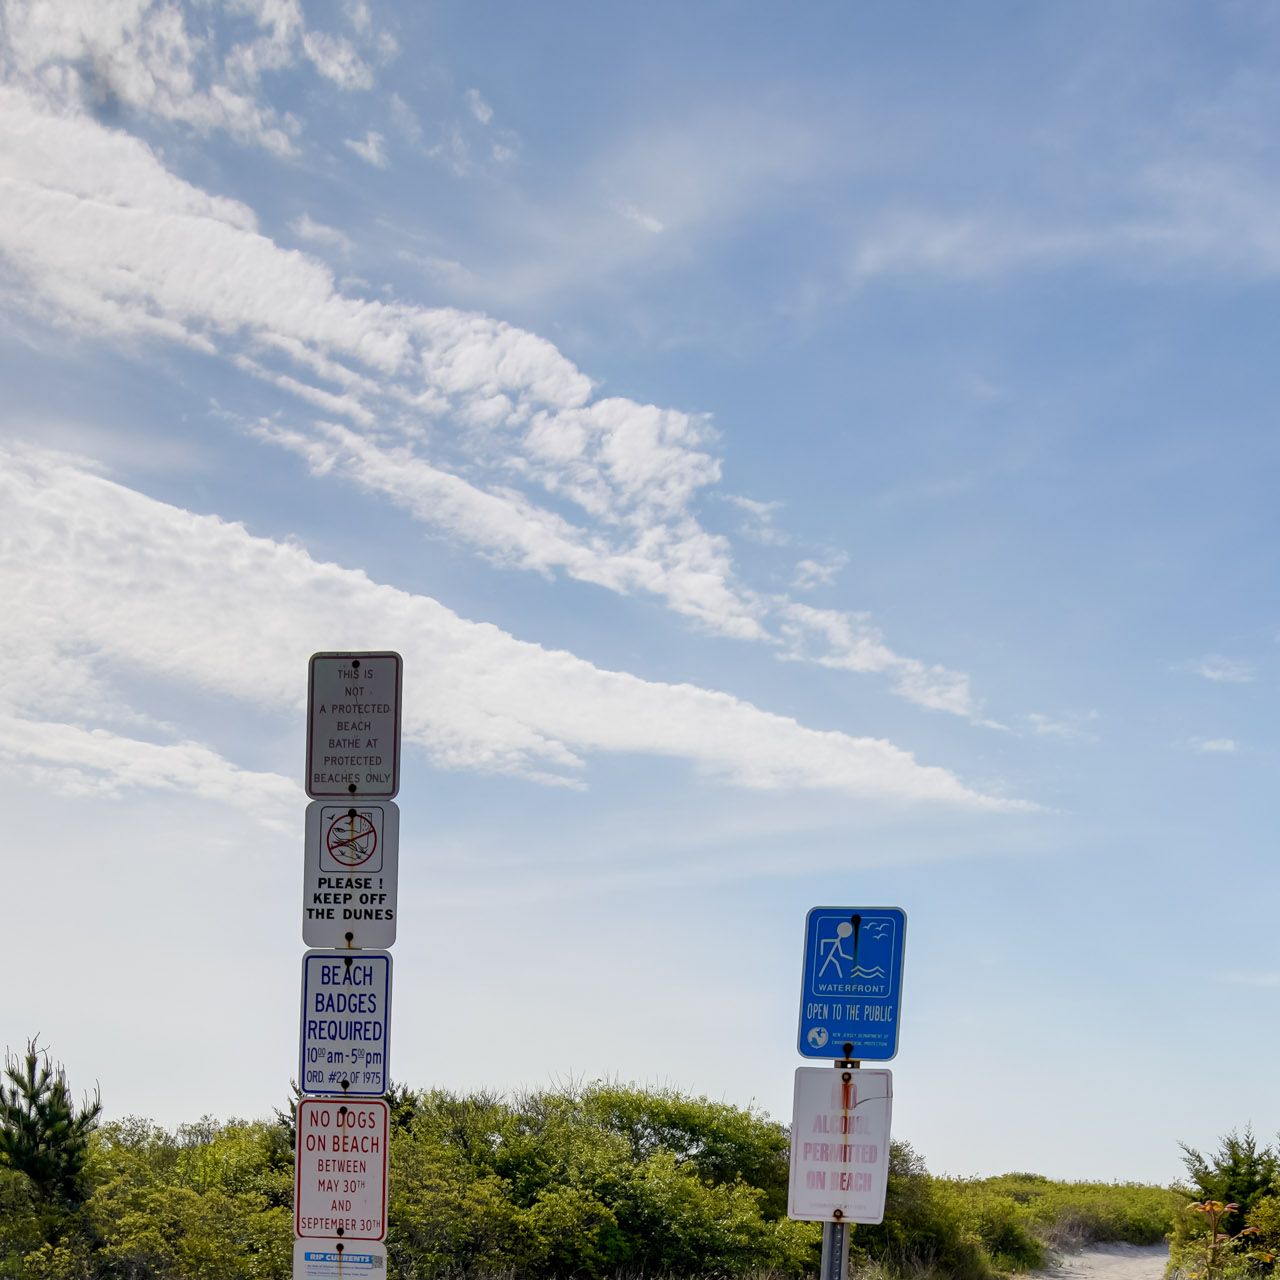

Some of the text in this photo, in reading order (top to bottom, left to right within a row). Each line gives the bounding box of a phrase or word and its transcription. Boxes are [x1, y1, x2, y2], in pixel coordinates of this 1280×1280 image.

[337, 669, 374, 679] THIS IS
[345, 687, 364, 696] NOT
[319, 704, 390, 714] A PROTECTED
[337, 721, 371, 731] BEACH
[328, 739, 378, 748] BATHE AT
[324, 756, 382, 766] PROTECTED
[314, 773, 391, 783] BEACHES ONLY
[318, 877, 372, 889] PLEASE
[313, 893, 387, 904] KEEP OFF
[306, 908, 393, 920] THE DUNES
[321, 965, 373, 986] BEACH
[818, 983, 885, 993] WATERFRONT
[315, 993, 376, 1013] BADGES
[807, 1003, 893, 1022] OPEN TO THE PUBLIC
[307, 1020, 382, 1041] REQUIRED
[350, 1072, 360, 1084] OF
[363, 1072, 381, 1084] 1975
[310, 1110, 376, 1129] NO DOGS
[306, 1134, 379, 1153] ON BEACH
[803, 1142, 878, 1163] PERMITTED
[318, 1159, 366, 1173] BETWEEN
[318, 1180, 339, 1192] MAY
[806, 1171, 872, 1192] ON BEACH
[331, 1200, 352, 1211] AND
[301, 1217, 360, 1231] SEPTEMBER
